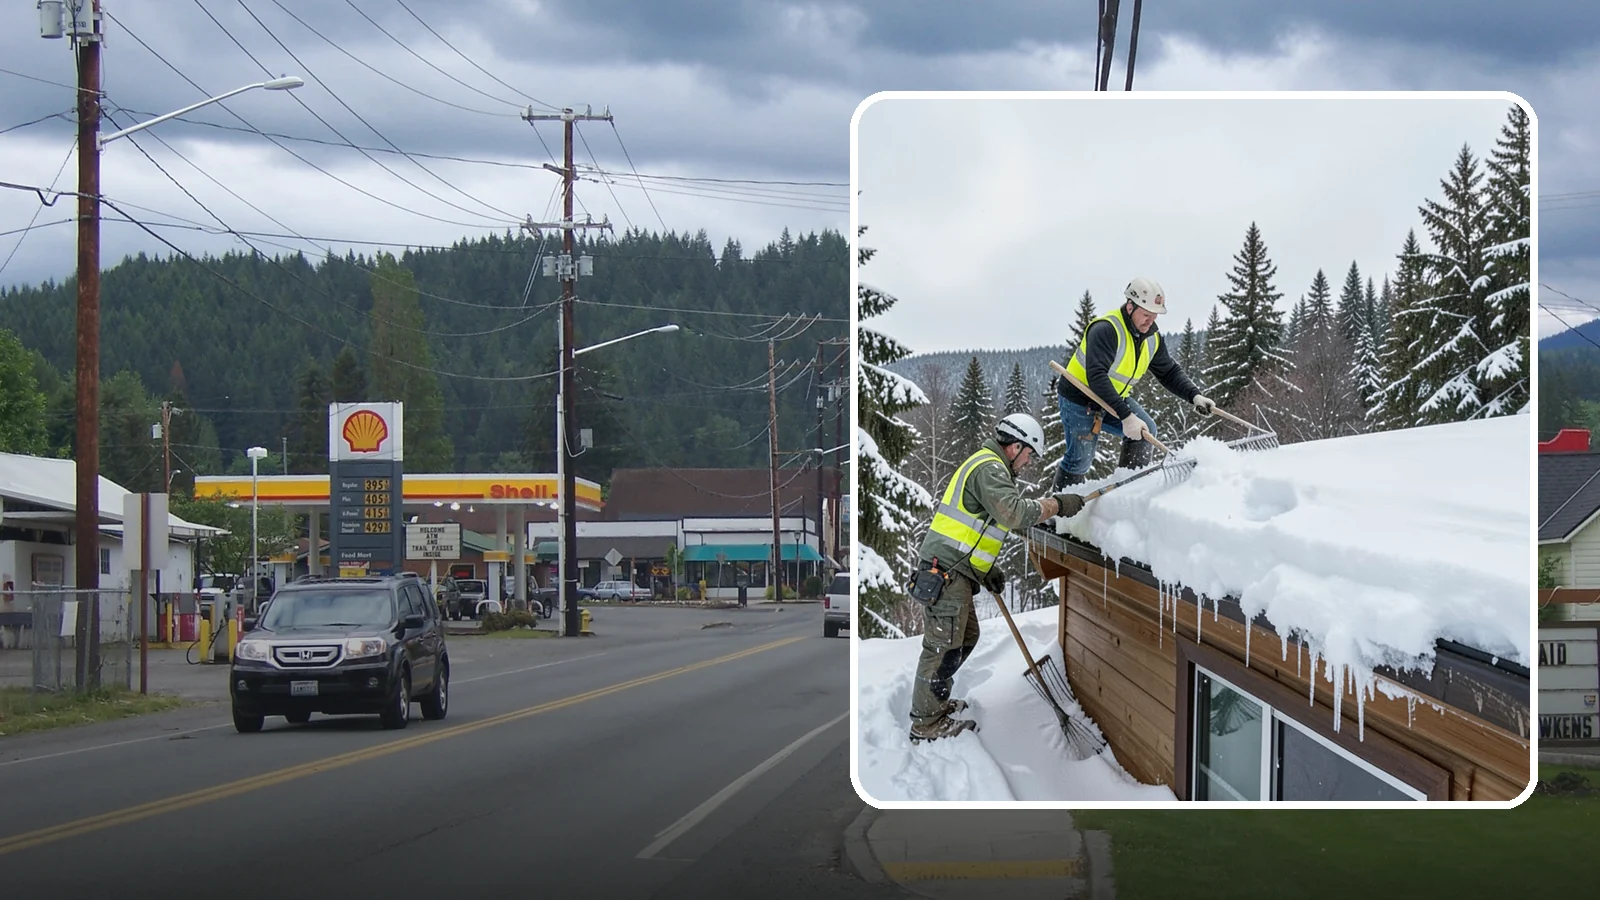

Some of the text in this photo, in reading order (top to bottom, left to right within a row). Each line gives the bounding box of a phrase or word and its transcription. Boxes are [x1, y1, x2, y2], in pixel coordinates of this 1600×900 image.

[366, 480, 383, 490] 395
[490, 484, 547, 499] Shell
[366, 494, 383, 504] 405
[366, 508, 383, 518] 415
[366, 522, 383, 532] 429
[1539, 643, 1566, 665] AID
